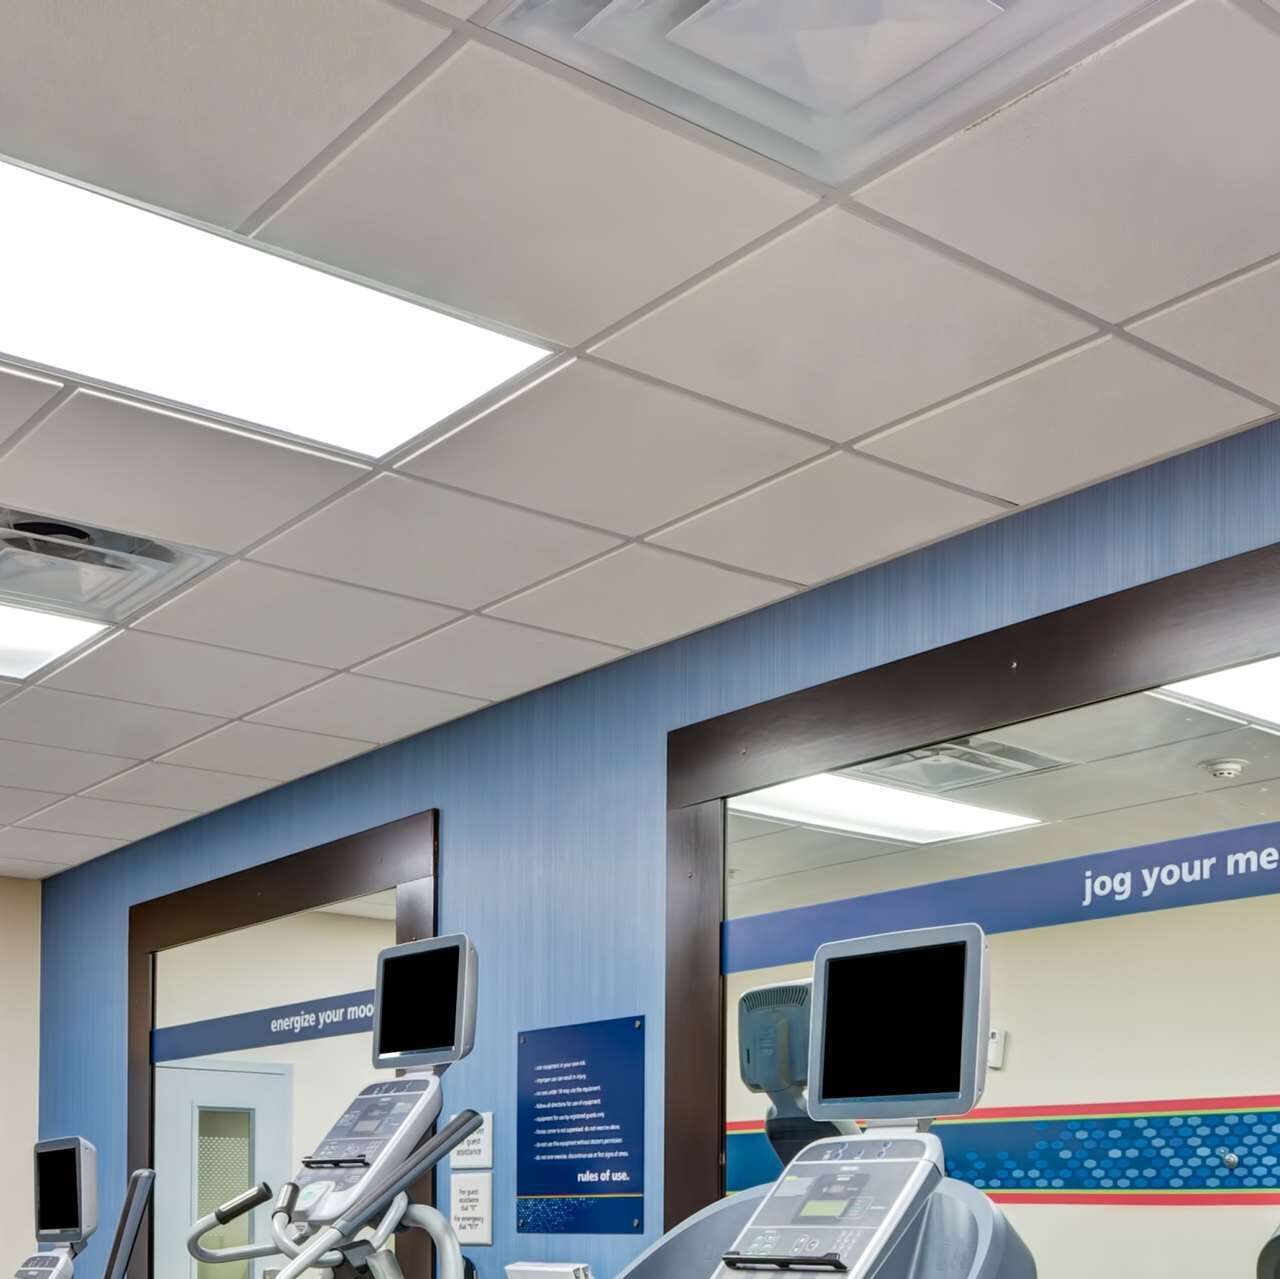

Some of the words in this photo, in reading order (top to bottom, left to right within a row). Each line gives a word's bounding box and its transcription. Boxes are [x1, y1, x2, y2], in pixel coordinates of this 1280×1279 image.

[1082, 870, 1131, 906] jog
[1142, 856, 1216, 897] your
[271, 1010, 316, 1033] energize
[318, 1006, 345, 1029] your
[347, 1003, 374, 1020] moo
[577, 1170, 599, 1183] rules
[600, 1169, 611, 1182] of
[611, 1171, 630, 1182] use.
